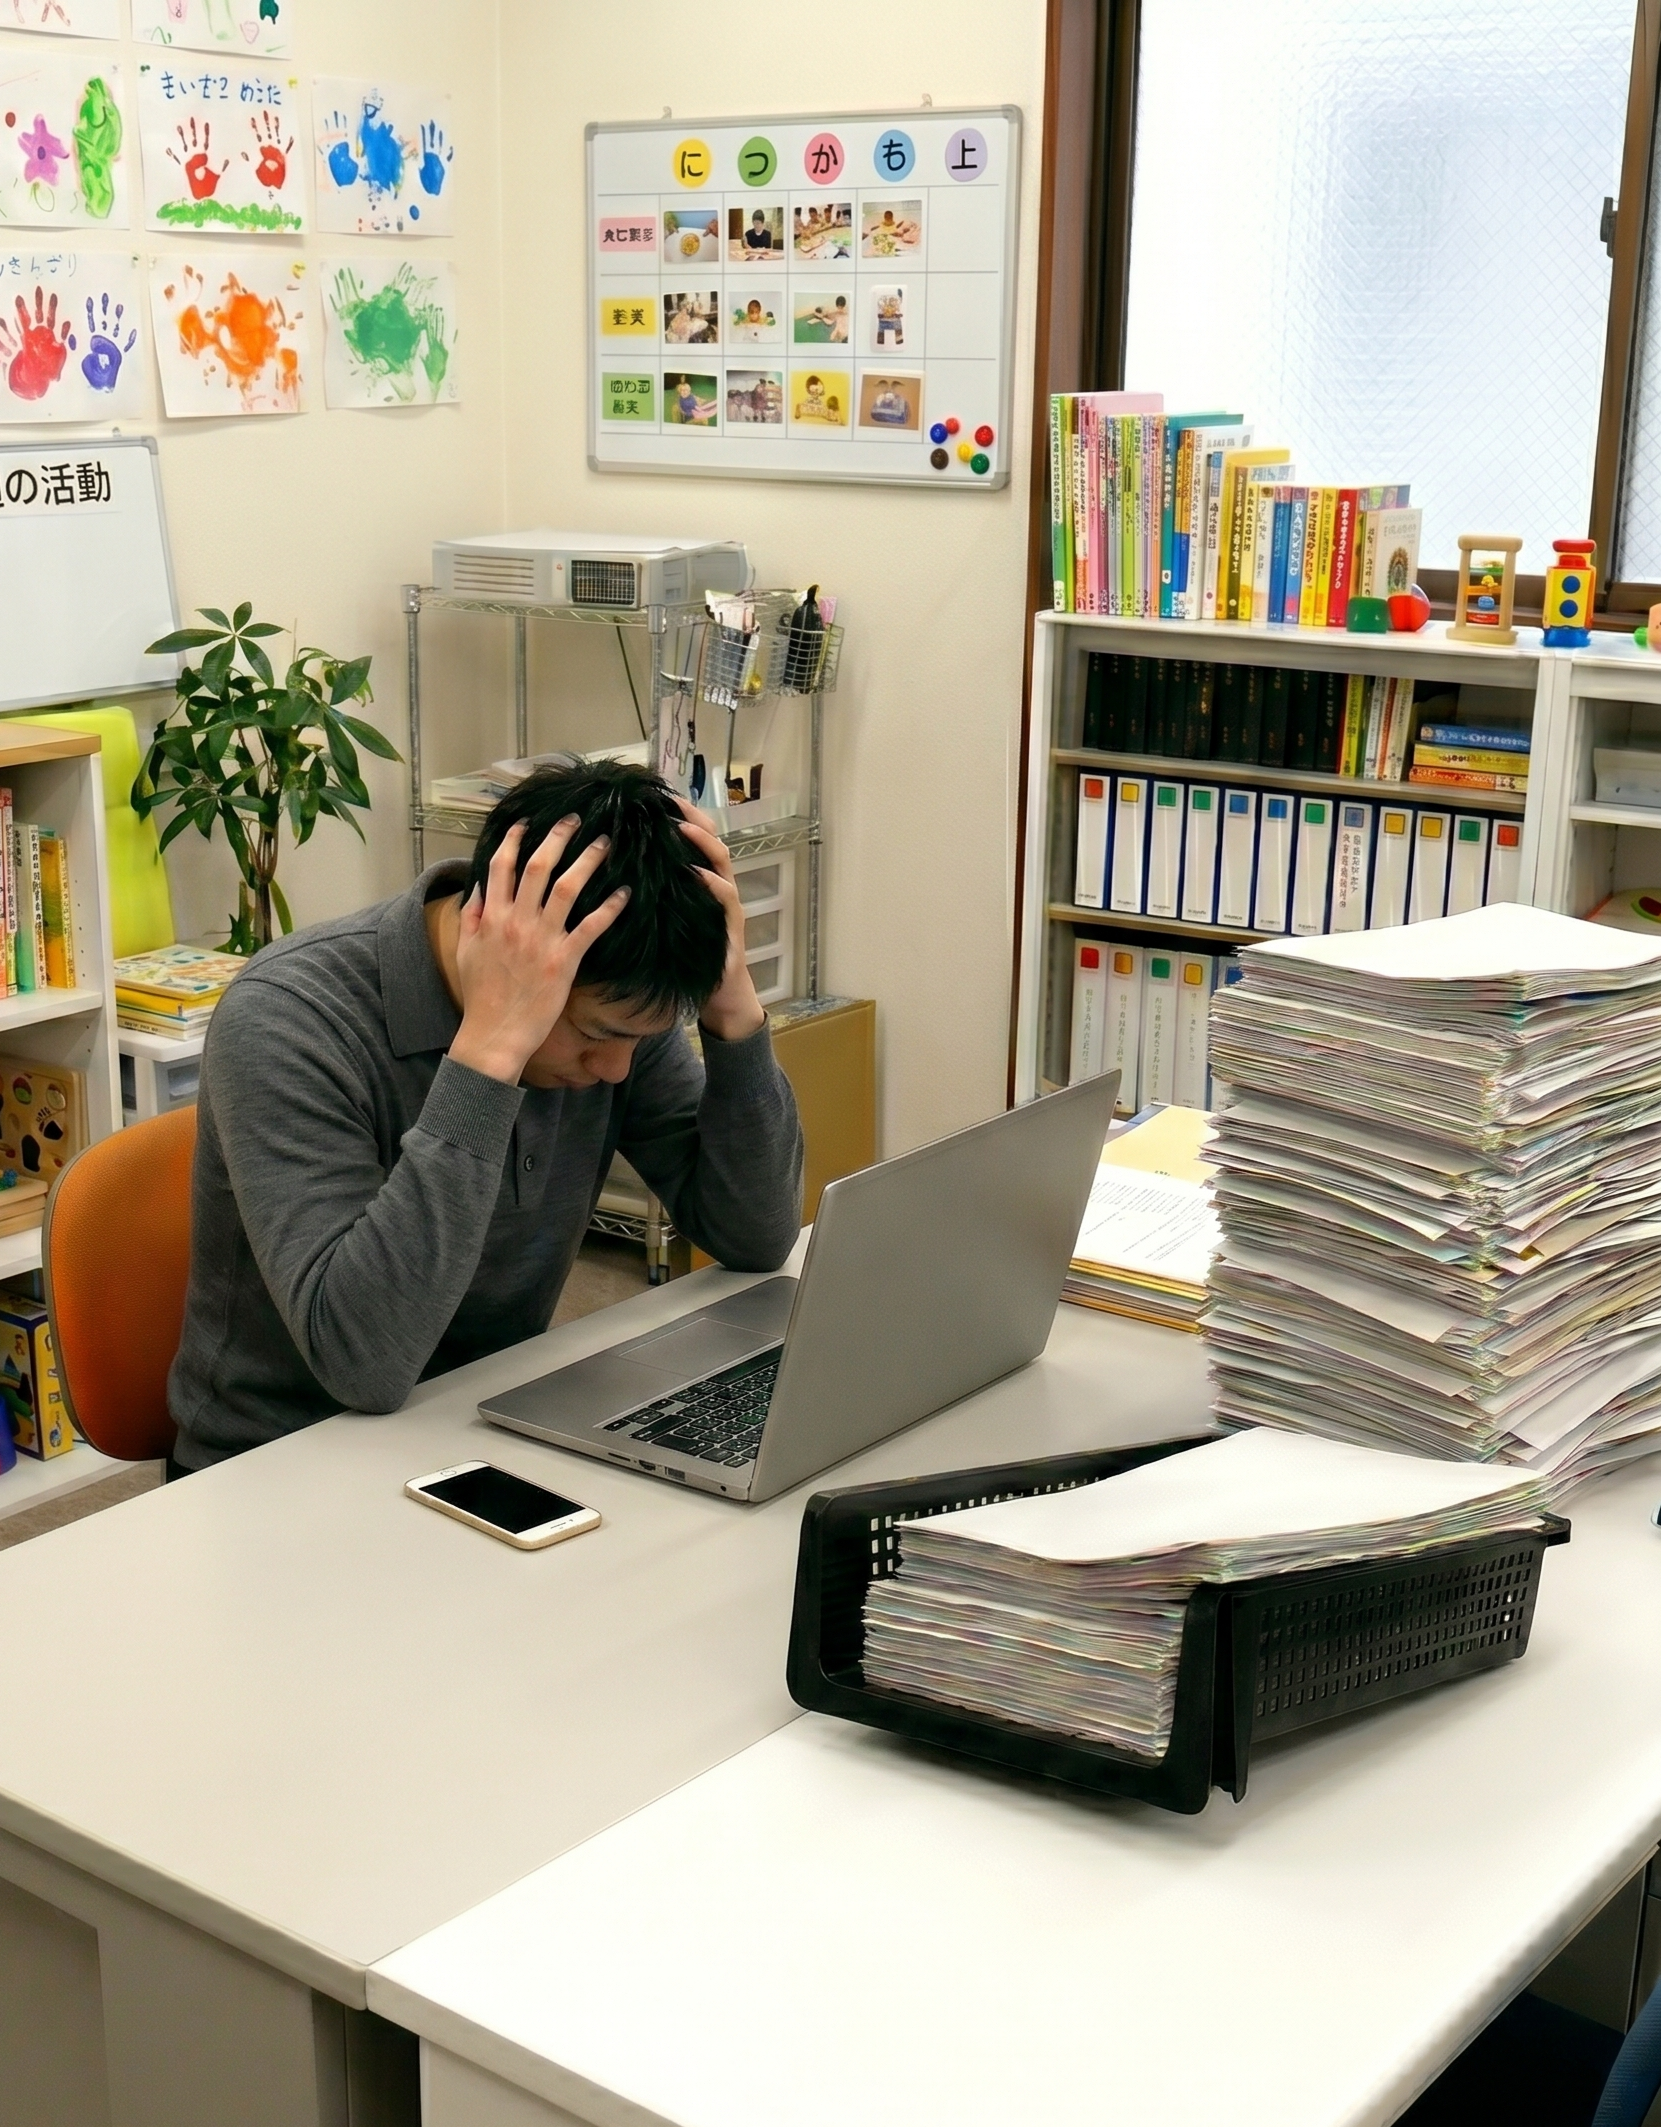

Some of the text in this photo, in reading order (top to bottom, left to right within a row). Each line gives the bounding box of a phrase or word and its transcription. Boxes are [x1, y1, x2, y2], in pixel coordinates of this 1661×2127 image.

[681, 138, 978, 179] に つ か も 上
[0, 460, 111, 508] の活動
